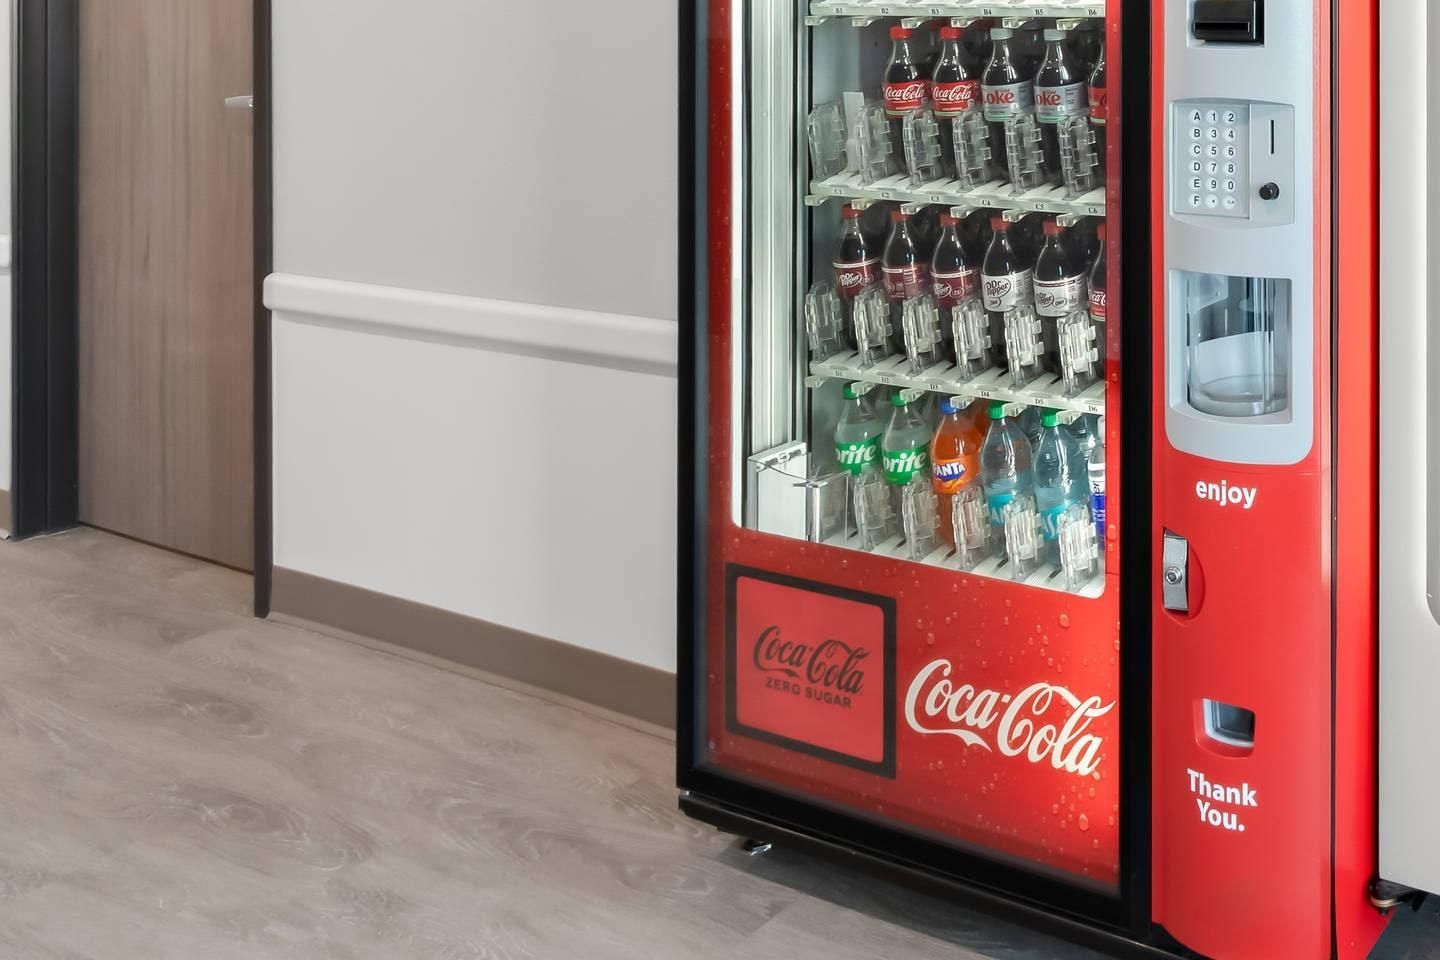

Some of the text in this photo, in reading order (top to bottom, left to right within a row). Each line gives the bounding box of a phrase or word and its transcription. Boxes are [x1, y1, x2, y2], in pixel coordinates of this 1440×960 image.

[1194, 112, 1200, 121] A
[1212, 113, 1216, 121] 1
[1194, 129, 1234, 139] B 3 4
[1194, 146, 1234, 156] C 5 6
[1194, 162, 1200, 171] D
[1228, 164, 1234, 173] 8
[1194, 179, 1234, 190] E 9 0
[1194, 196, 1199, 204] F
[1196, 480, 1256, 509] enjoy
[753, 624, 871, 696] Coca-Cola
[764, 677, 852, 710] ZERO SUGAR
[904, 658, 1116, 776] Coca-Cola
[1187, 768, 1258, 807] Thank
[1196, 800, 1244, 831] You.
